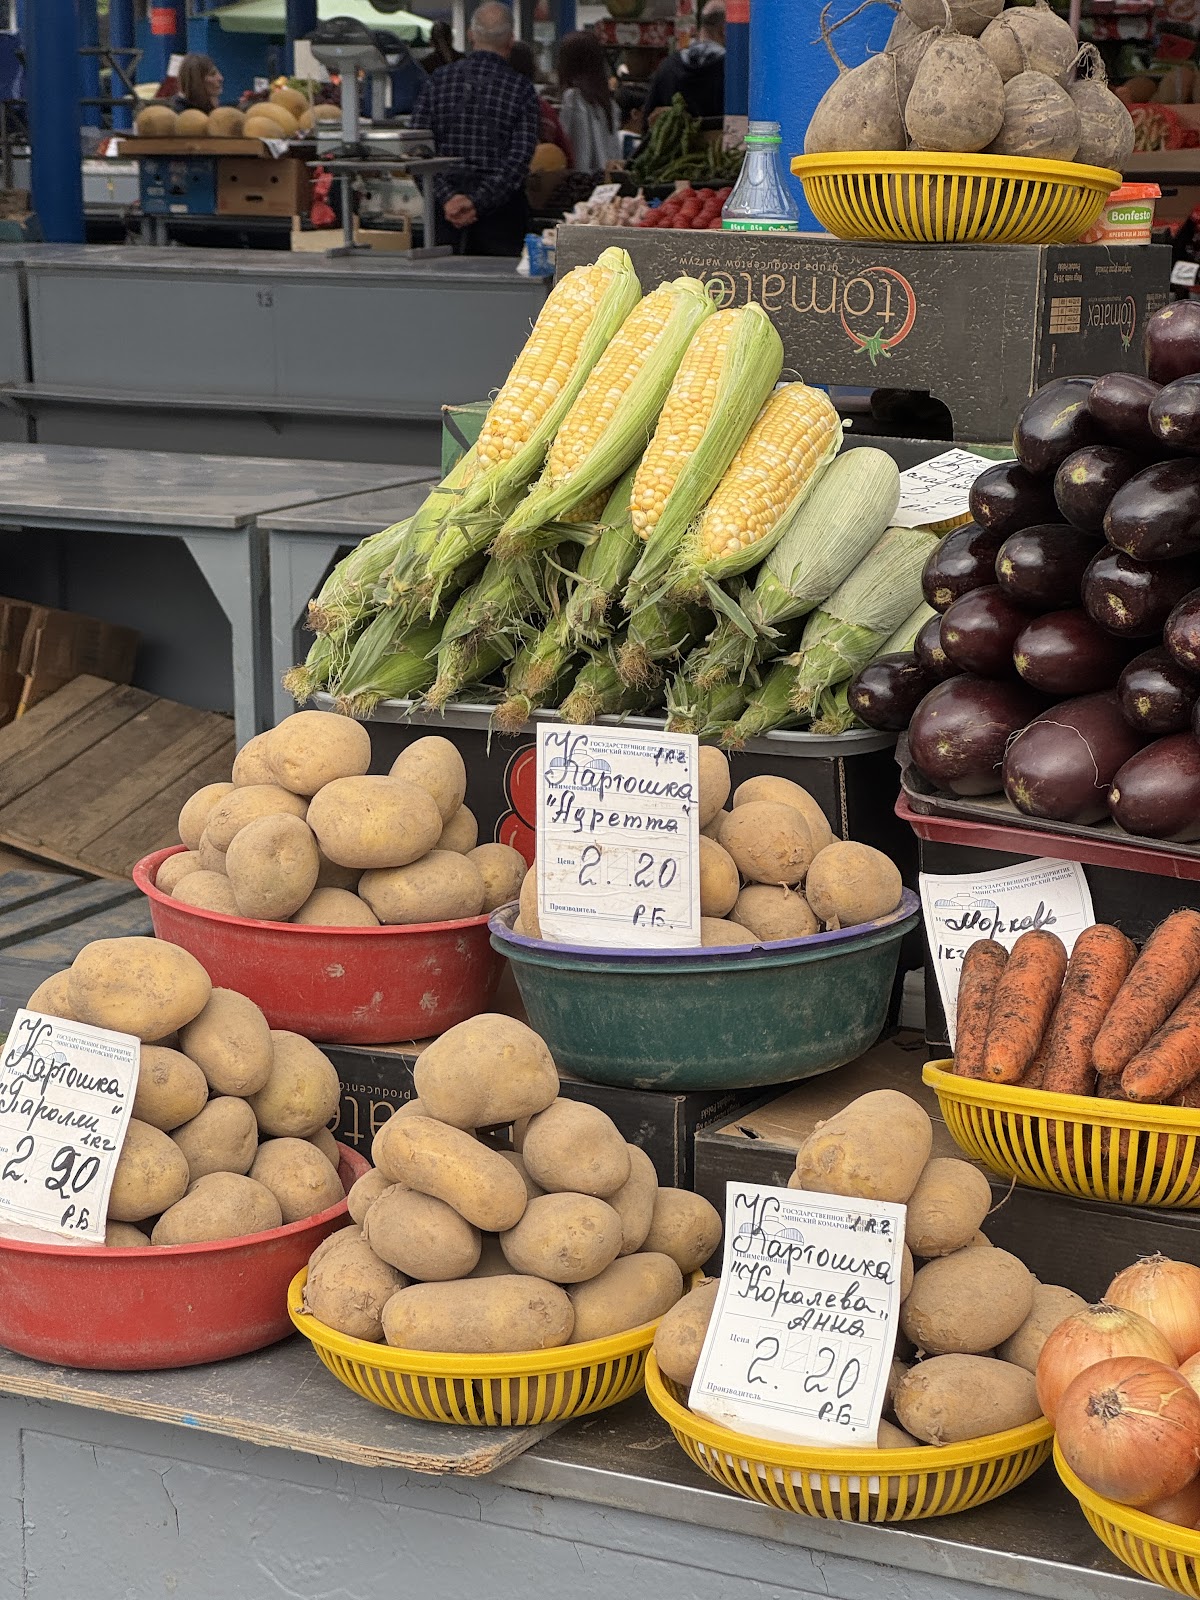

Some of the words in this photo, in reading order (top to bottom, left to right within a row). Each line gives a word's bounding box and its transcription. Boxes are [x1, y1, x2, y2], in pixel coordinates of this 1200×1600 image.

[1111, 210, 1151, 221] Bonfesto
[806, 262, 839, 272] grupa
[1088, 303, 1132, 329] tomatex
[590, 741, 646, 752] ГОСУДАРСТВЕННОЕ
[544, 730, 698, 803] Картошка
[557, 857, 575, 866] Цена
[972, 876, 1030, 890] ГОСУДАРСТВЕННОЕ
[1006, 878, 1051, 892] КОМАРОВСКИЙ
[550, 902, 596, 914] Производитель
[945, 901, 1058, 940] Морковь
[5, 1018, 124, 1098] Картошка
[339, 1082, 411, 1100] producentó
[782, 1207, 845, 1222] ГОСУДАРСТВЕННОЕ
[732, 1192, 894, 1285] Картошка
[736, 1250, 788, 1265] Наименовани
[787, 1308, 866, 1338] Анна
[729, 1333, 750, 1345] Цена
[706, 1381, 762, 1401] Производитель
